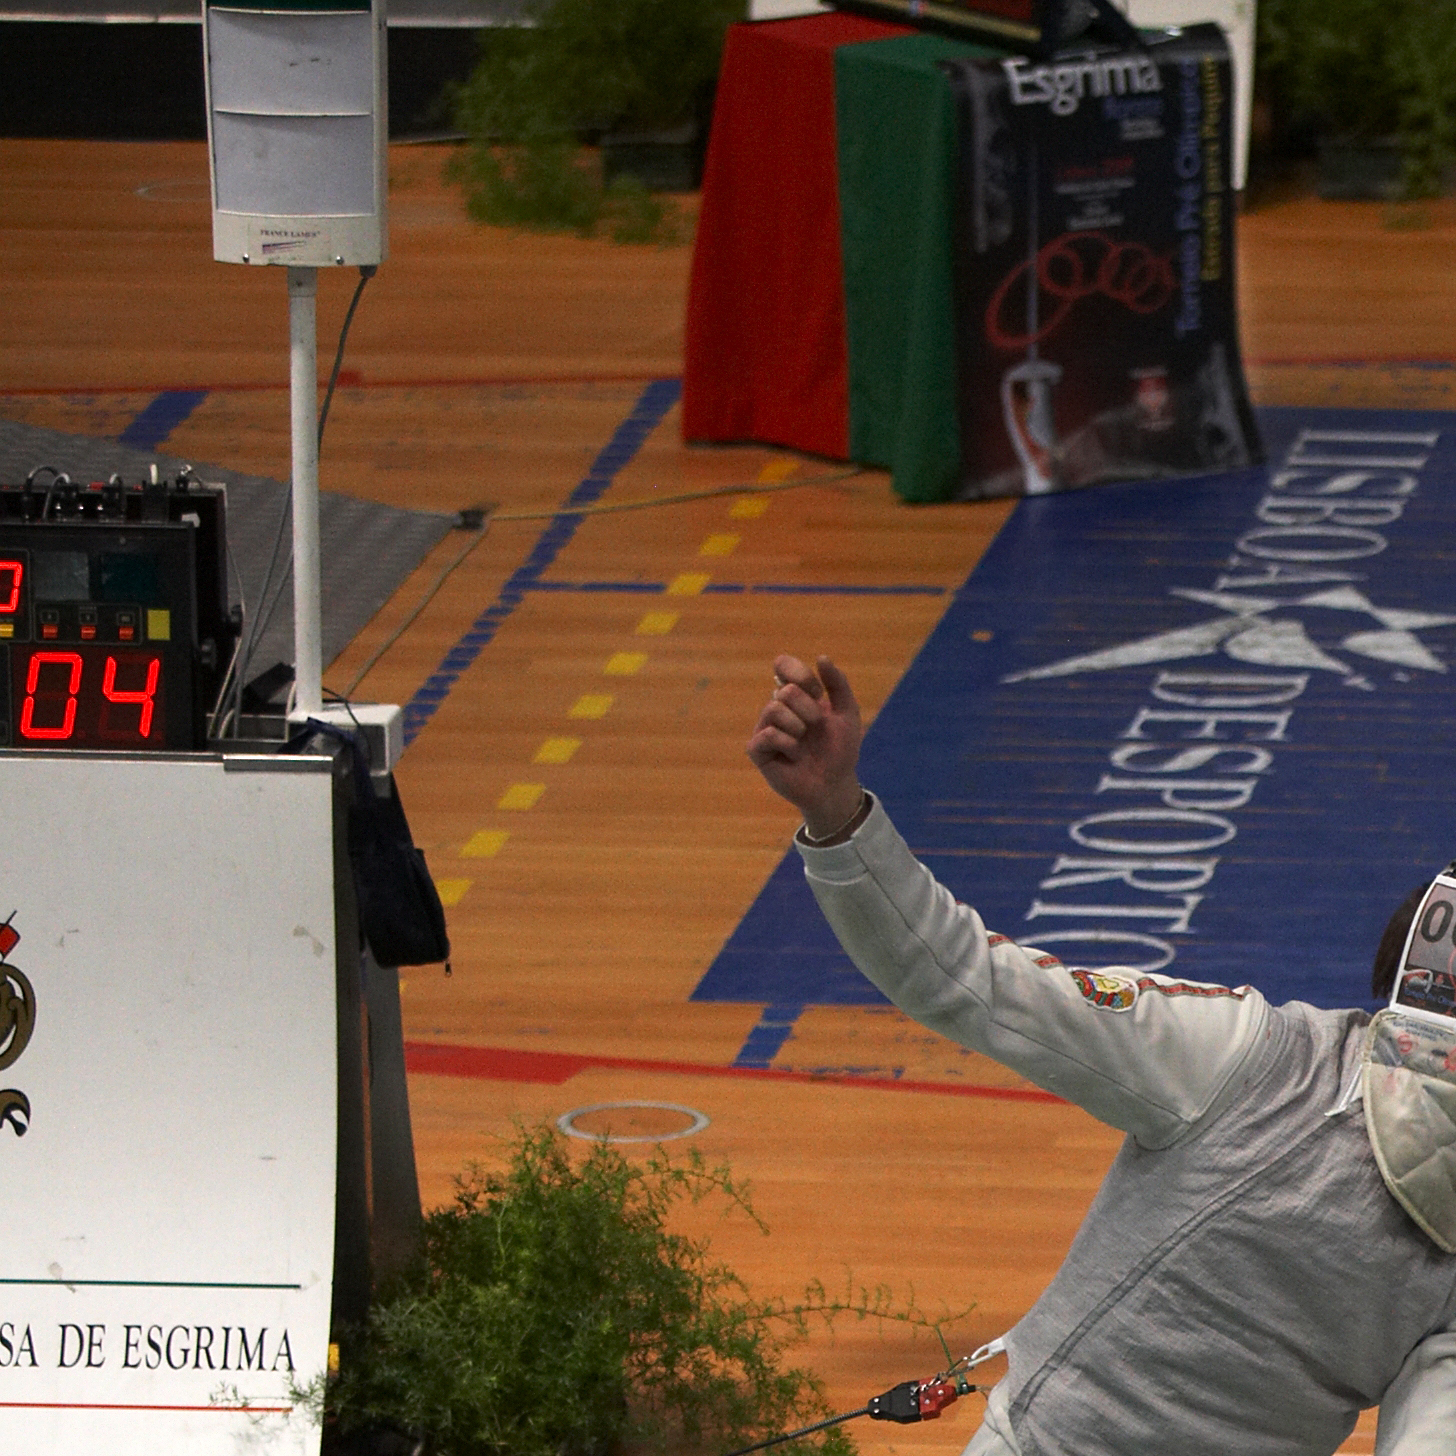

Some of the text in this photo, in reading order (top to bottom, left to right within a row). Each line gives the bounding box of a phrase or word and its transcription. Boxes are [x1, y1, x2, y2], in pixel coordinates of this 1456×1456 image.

[1001, 55, 1162, 116] Esgrima
[1214, 429, 1441, 591] LISBOA
[20, 652, 161, 740] 04
[1014, 671, 1310, 973] DESPORTO
[57, 1324, 106, 1368] DE
[121, 1325, 297, 1371] ESGRIMA
